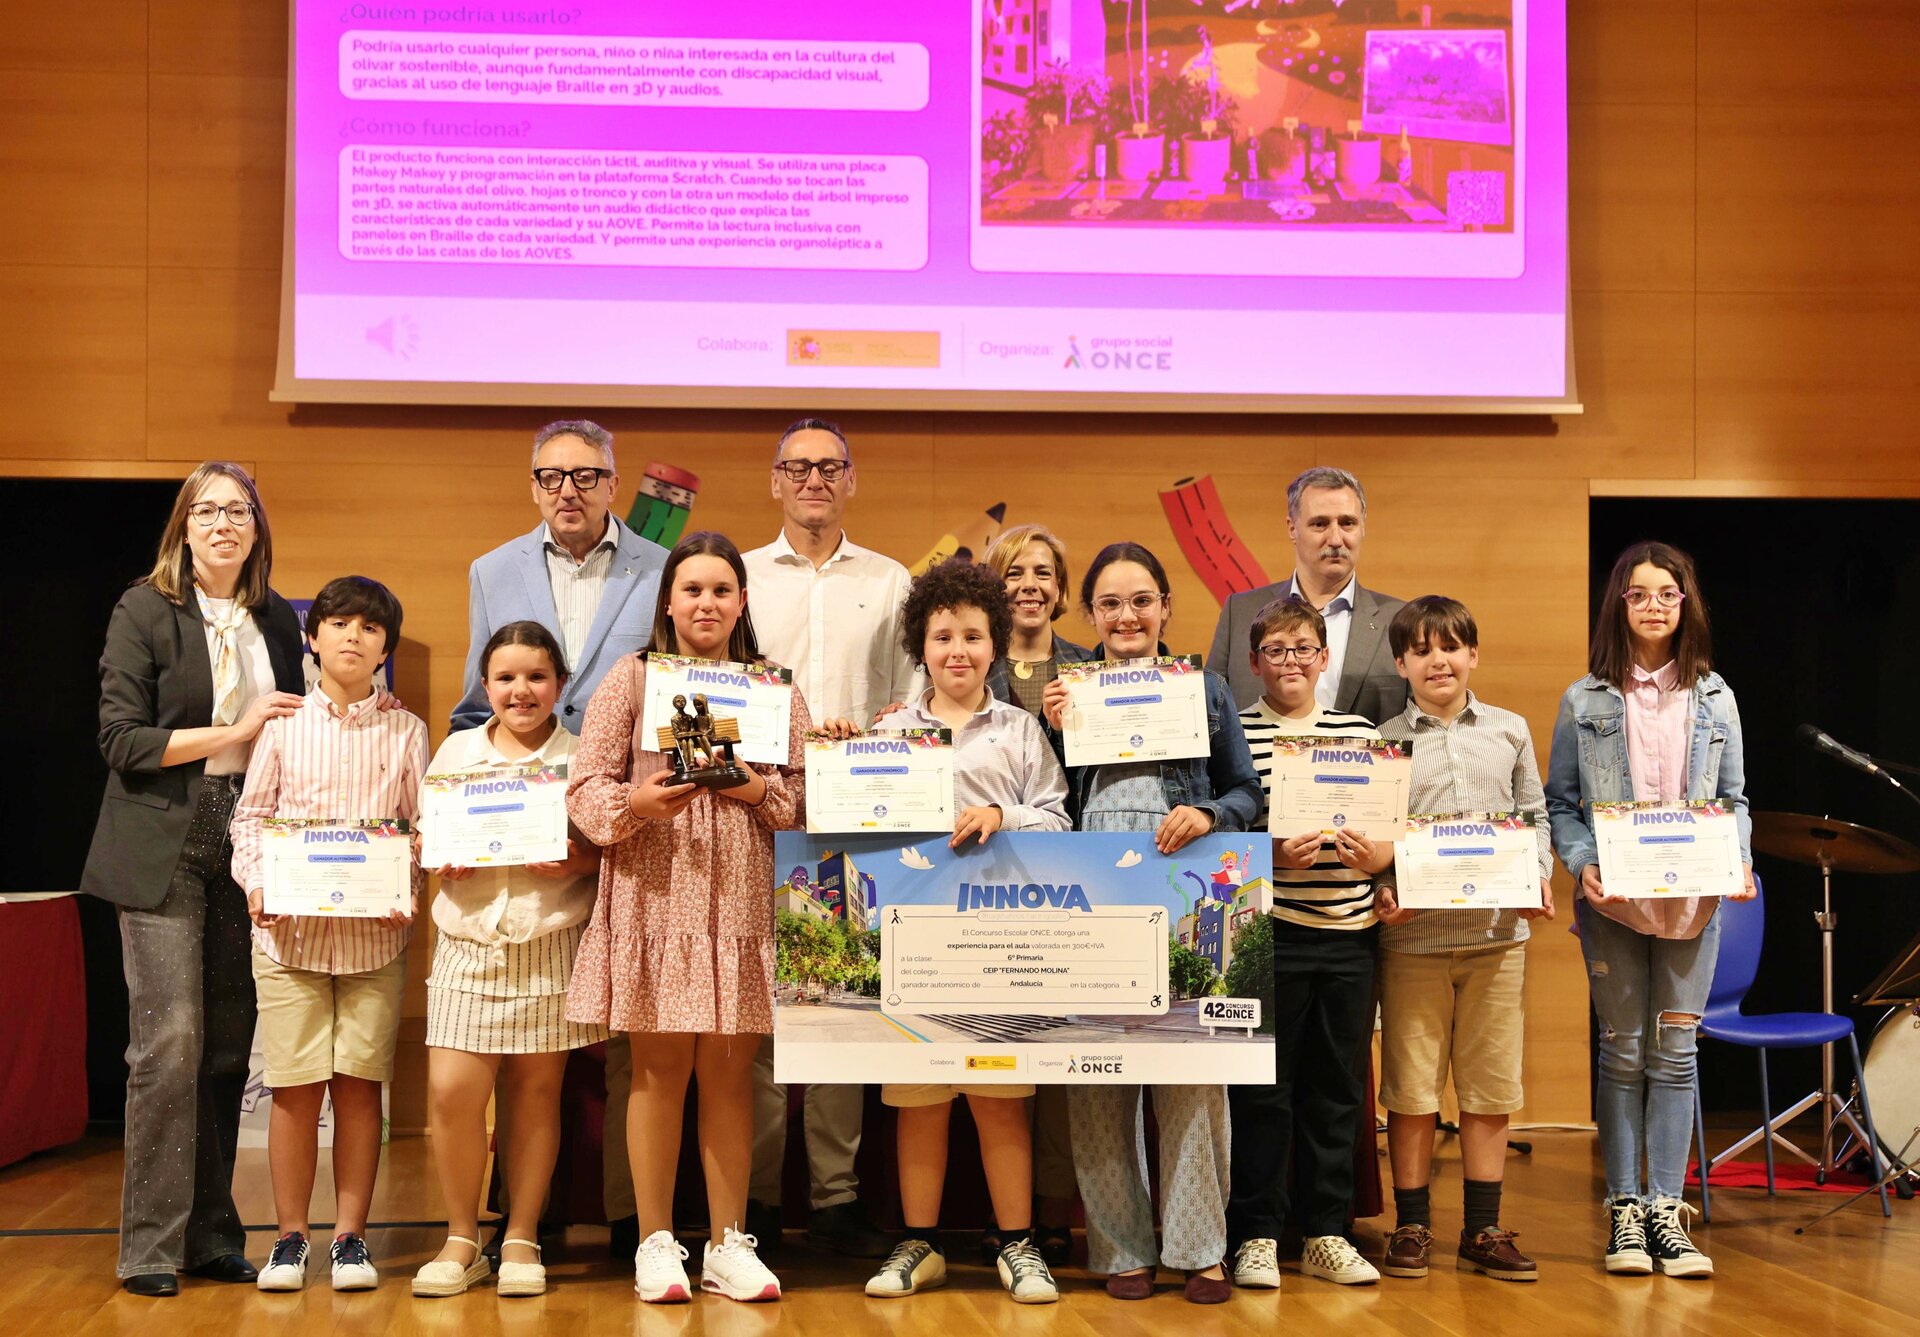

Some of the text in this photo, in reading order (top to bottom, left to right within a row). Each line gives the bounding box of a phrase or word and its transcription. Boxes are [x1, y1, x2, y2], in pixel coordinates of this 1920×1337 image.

[502, 9, 581, 25] usarlo?
[406, 41, 454, 54] usarlo
[458, 42, 530, 59] cualquier
[688, 47, 768, 61] interesada
[812, 50, 866, 63] cultura
[870, 51, 895, 63] del
[352, 58, 395, 71] olivar
[485, 64, 544, 77] aunque
[547, 62, 695, 77] fundamentalmente
[698, 68, 727, 78] con
[730, 66, 832, 83] discapacidad
[352, 76, 408, 92] gracias
[430, 81, 458, 90] uso
[460, 78, 481, 91] de
[485, 79, 552, 95] lenguaje
[556, 80, 605, 93] Braille
[632, 82, 653, 94] 3D
[423, 120, 531, 138] funciona?
[352, 150, 365, 162] El
[368, 150, 432, 166] producto
[435, 152, 494, 164] funciona
[497, 156, 523, 164] con
[643, 156, 697, 168] auditiva
[757, 158, 774, 169] Se
[777, 158, 817, 170] utiliza
[820, 162, 846, 171] una
[848, 160, 886, 174] placa
[352, 166, 397, 180] Makey
[400, 166, 445, 181] Makey
[594, 170, 669, 186] plataforma
[729, 173, 783, 185] Cuando
[804, 174, 842, 186] tocan
[846, 175, 865, 186] las
[352, 182, 395, 197] partes
[398, 183, 462, 195] naturales
[465, 184, 488, 195] del
[530, 185, 566, 200] hojas
[582, 186, 627, 198] tronco
[641, 190, 667, 198] con
[685, 188, 712, 199] otra
[736, 189, 789, 201] modelo
[792, 190, 814, 201] del
[854, 191, 909, 206] impreso
[416, 199, 457, 210] activa
[603, 202, 642, 214] audio
[709, 207, 736, 218] que
[739, 205, 788, 220] explica
[790, 206, 810, 217] las
[454, 215, 473, 226] de
[476, 216, 509, 227] cada
[512, 216, 572, 228] variedad
[651, 218, 704, 230] Permite
[722, 220, 770, 232] lectura
[774, 221, 832, 233] inclusiva
[835, 224, 861, 233] con
[352, 228, 406, 244] paneles
[430, 230, 474, 242] Braille
[476, 231, 495, 242] de
[497, 231, 531, 243] cada
[613, 233, 667, 248] permite
[669, 237, 695, 246] una
[697, 235, 776, 250] experiencia
[395, 245, 414, 256] de
[417, 245, 436, 257] las
[439, 246, 476, 257] catas
[479, 246, 498, 258] de
[500, 247, 520, 258] los
[697, 337, 773, 352] Colabora:
[980, 342, 1054, 358] Organiza:
[1091, 336, 1172, 349] grupo social
[1091, 352, 1172, 370] ONCE
[687, 669, 751, 689] INNOVA
[1100, 670, 1164, 687] INNOVA
[846, 742, 912, 756] INNOVA
[1312, 750, 1374, 765] INNOVA
[464, 780, 528, 797] INNOVA
[1633, 812, 1696, 826] INNOVA
[304, 830, 370, 844] INNOVA
[1433, 825, 1496, 838] INNOVA
[957, 883, 1092, 912] INNOVA
[1054, 930, 1075, 938] otorga
[947, 942, 988, 950] experiencia
[1204, 1002, 1225, 1018] 42
[1226, 1009, 1254, 1019] ONCE
[1081, 1063, 1122, 1073] ONCE
